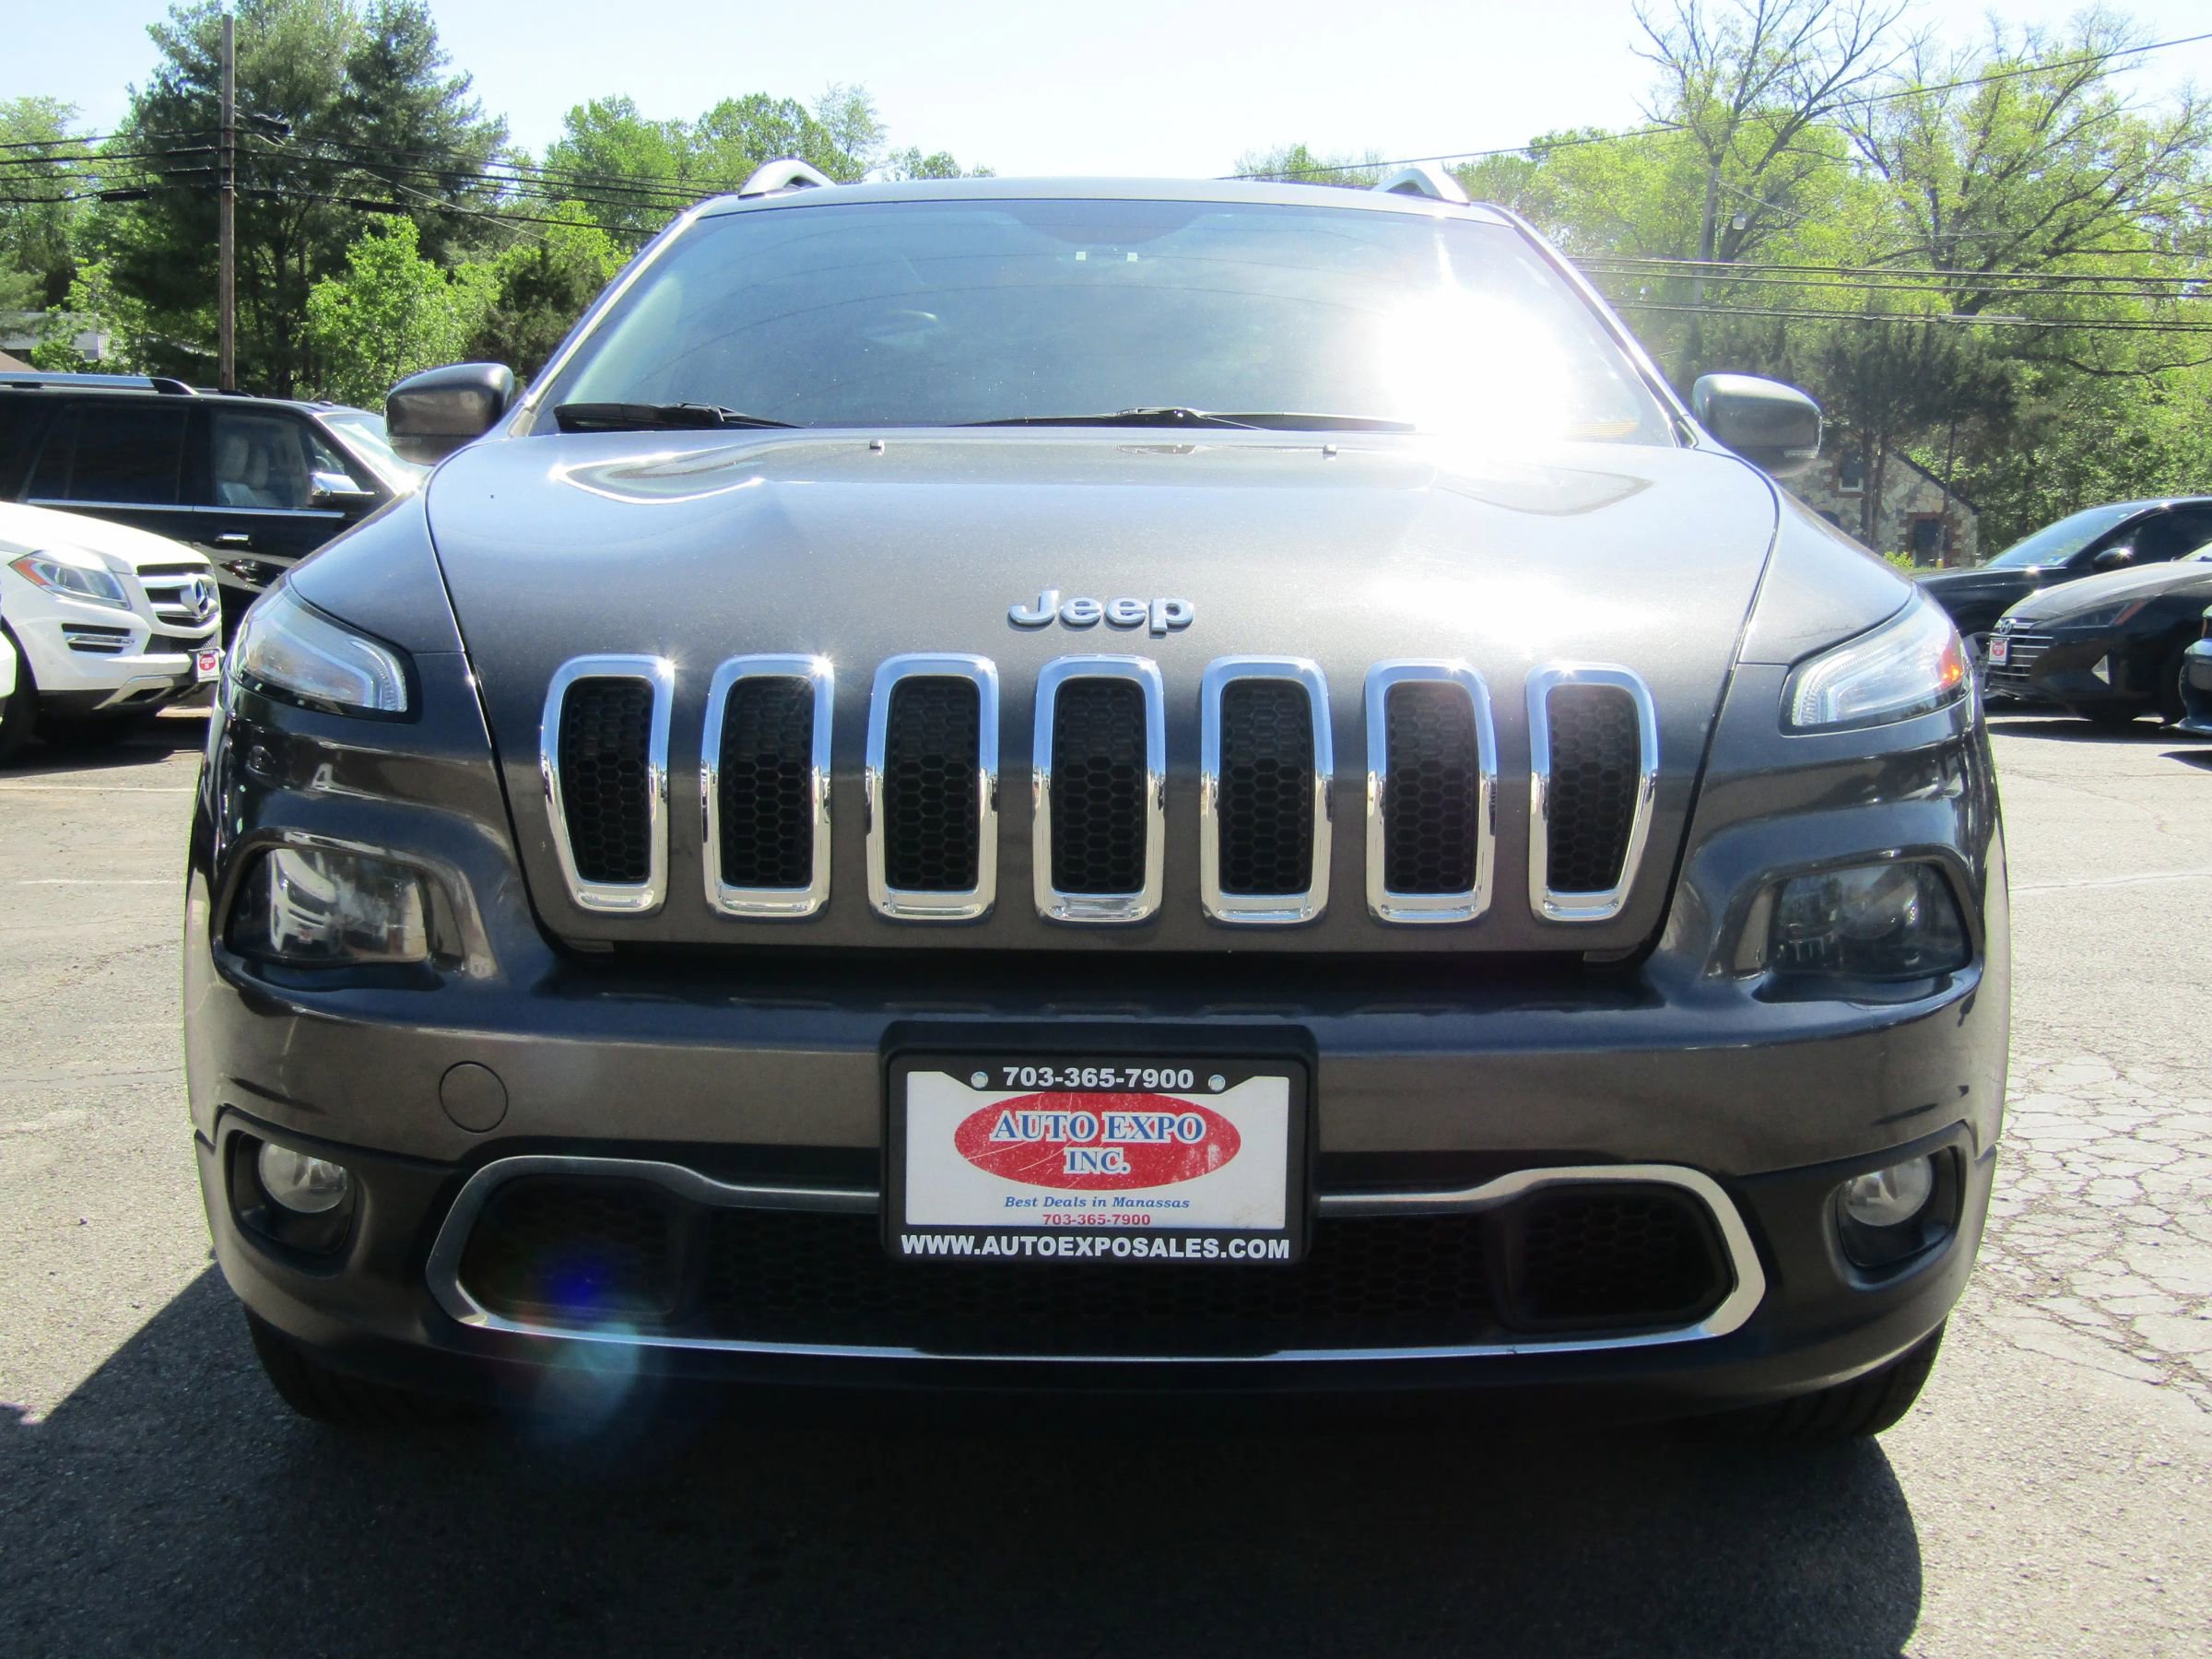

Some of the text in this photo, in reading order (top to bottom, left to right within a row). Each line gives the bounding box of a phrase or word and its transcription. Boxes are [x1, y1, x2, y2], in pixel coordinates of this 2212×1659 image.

[1008, 590, 1194, 634] Jeep
[1003, 1067, 1194, 1088] 703-365-7900
[991, 1111, 1206, 1144] AUTO EXPO
[1064, 1147, 1131, 1174] INC.
[1005, 1196, 1190, 1209] Best Deals in Manassas
[1042, 1214, 1151, 1226] 703-365-7900
[901, 1235, 1289, 1260] WWW.AUTOEXPOSALES.COM
